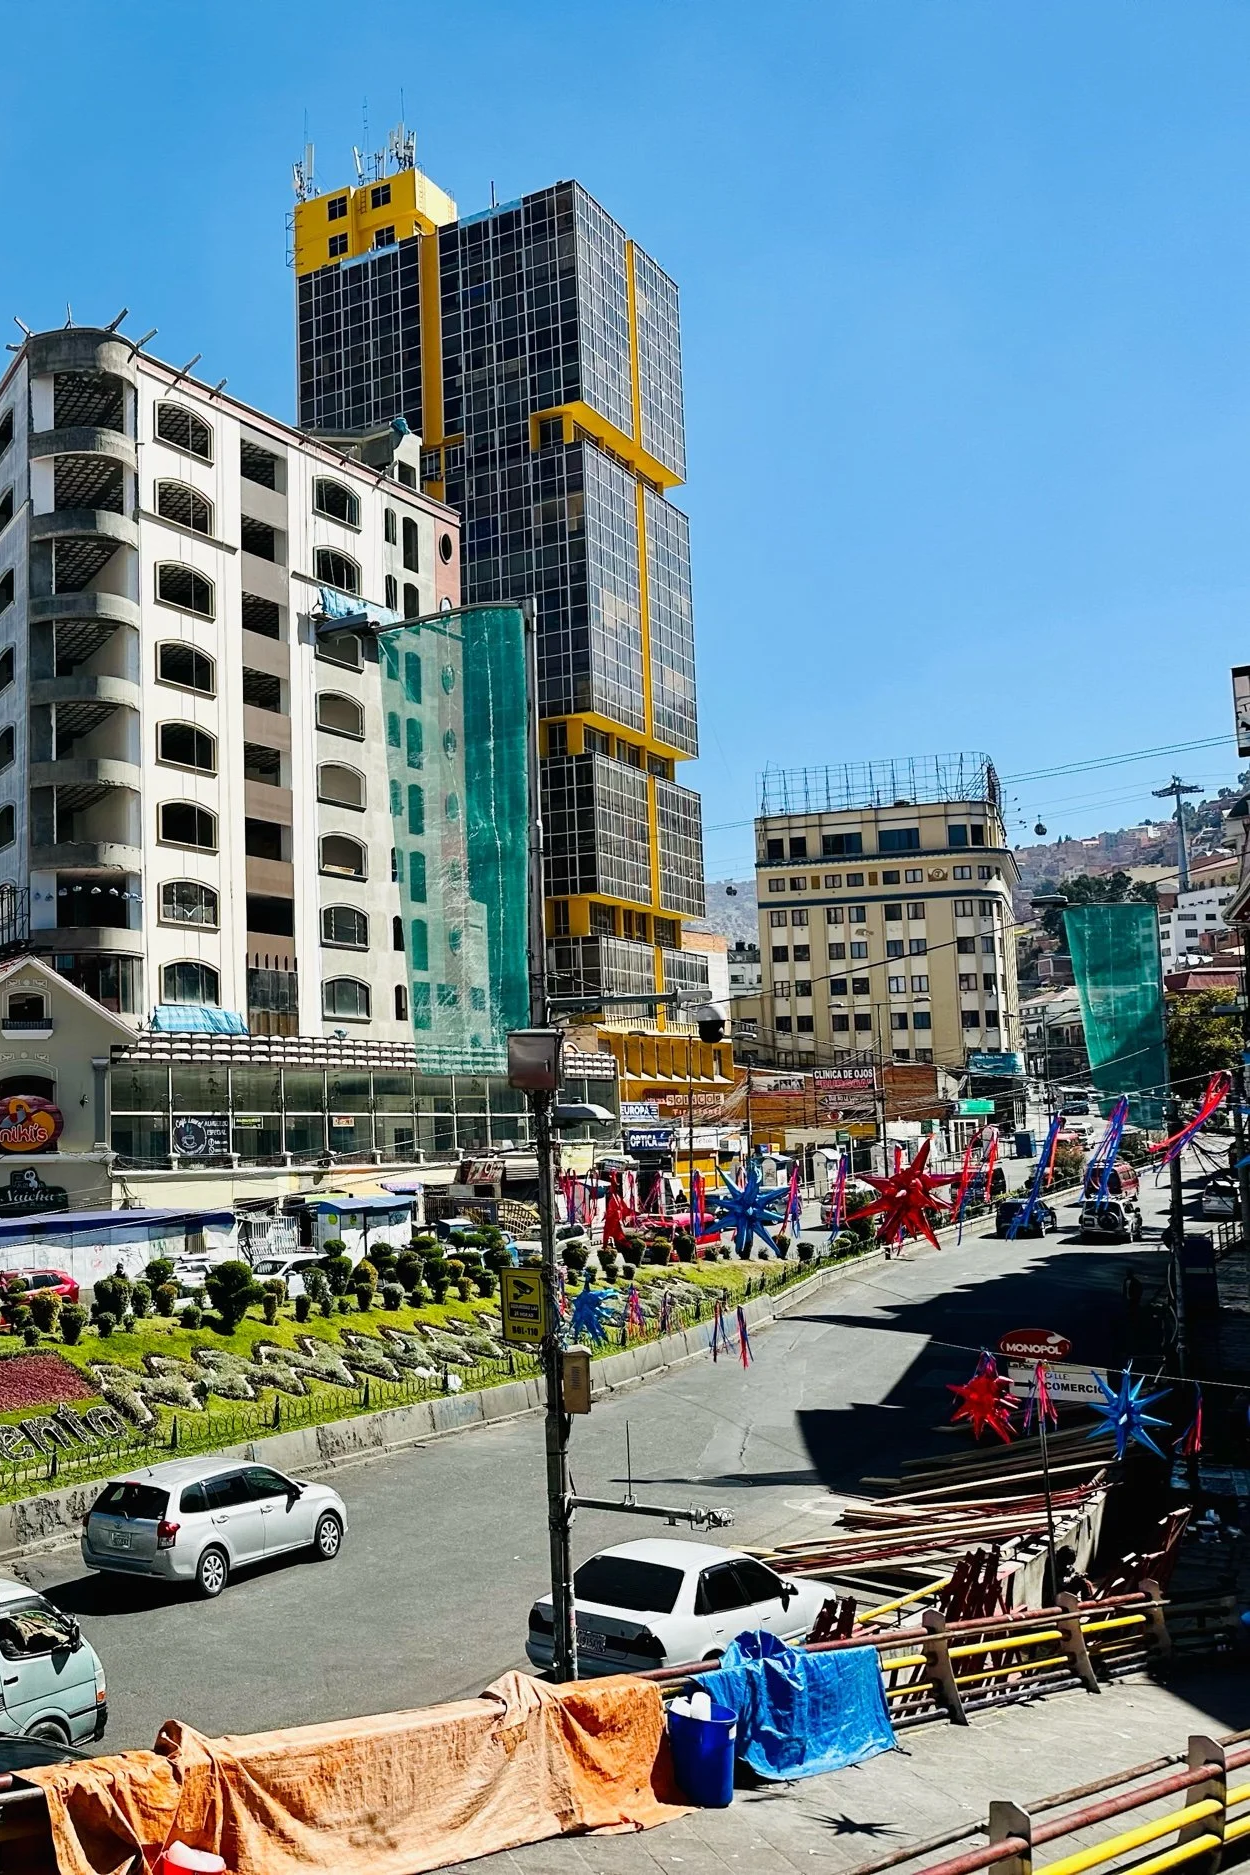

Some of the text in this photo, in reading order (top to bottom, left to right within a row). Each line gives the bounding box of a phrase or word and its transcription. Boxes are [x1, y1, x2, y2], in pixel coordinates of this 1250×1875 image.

[843, 1069, 853, 1079] DE
[854, 1068, 873, 1079] OJOS
[621, 1105, 650, 1115] EUROPA
[630, 1135, 657, 1147] OPTICA
[1006, 1342, 1062, 1355] MONOPOL
